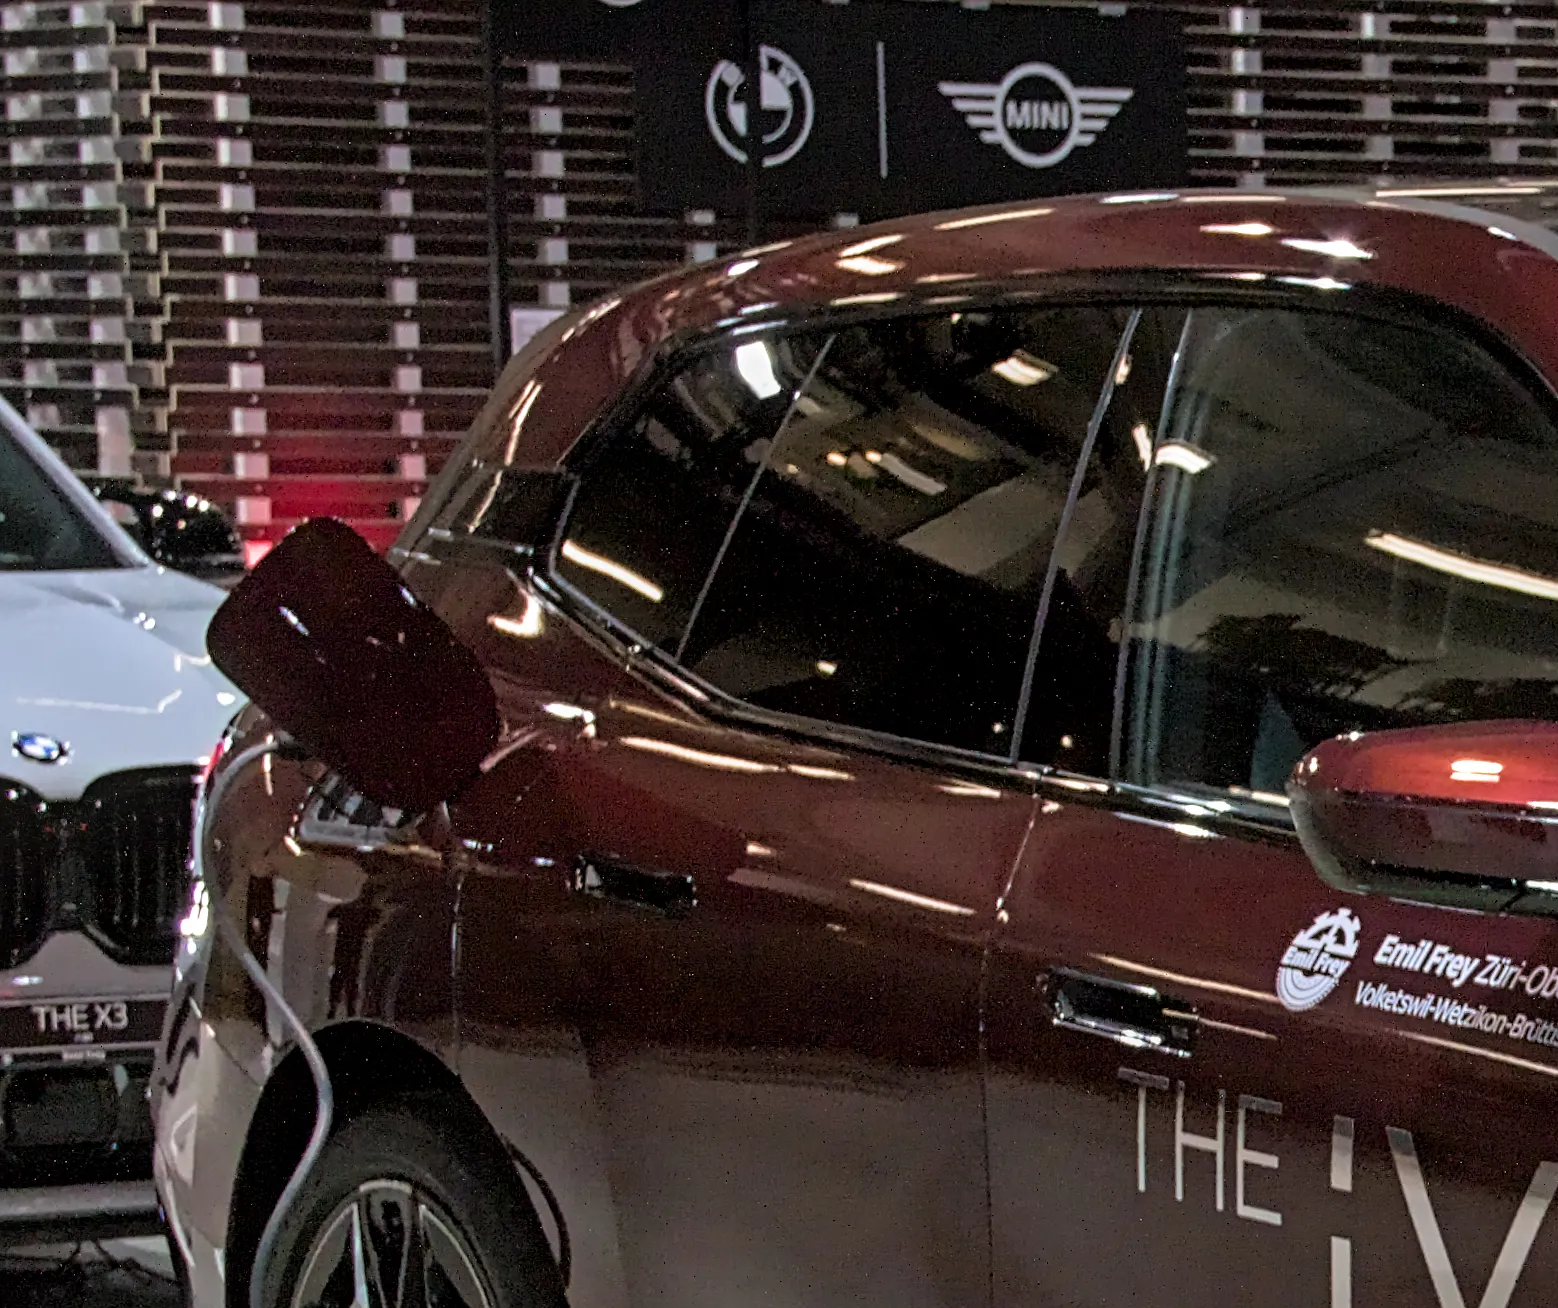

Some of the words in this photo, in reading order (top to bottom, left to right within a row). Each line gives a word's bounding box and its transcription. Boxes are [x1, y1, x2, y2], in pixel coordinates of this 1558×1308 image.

[1005, 100, 1069, 130] MINI
[1281, 945, 1320, 972] Emil
[1313, 952, 1351, 978] Frey
[1373, 933, 1434, 972] Emil
[1423, 944, 1480, 988] Frey
[33, 1003, 90, 1032] THE
[94, 1002, 129, 1030] X3
[1117, 1066, 1283, 1226] THE
